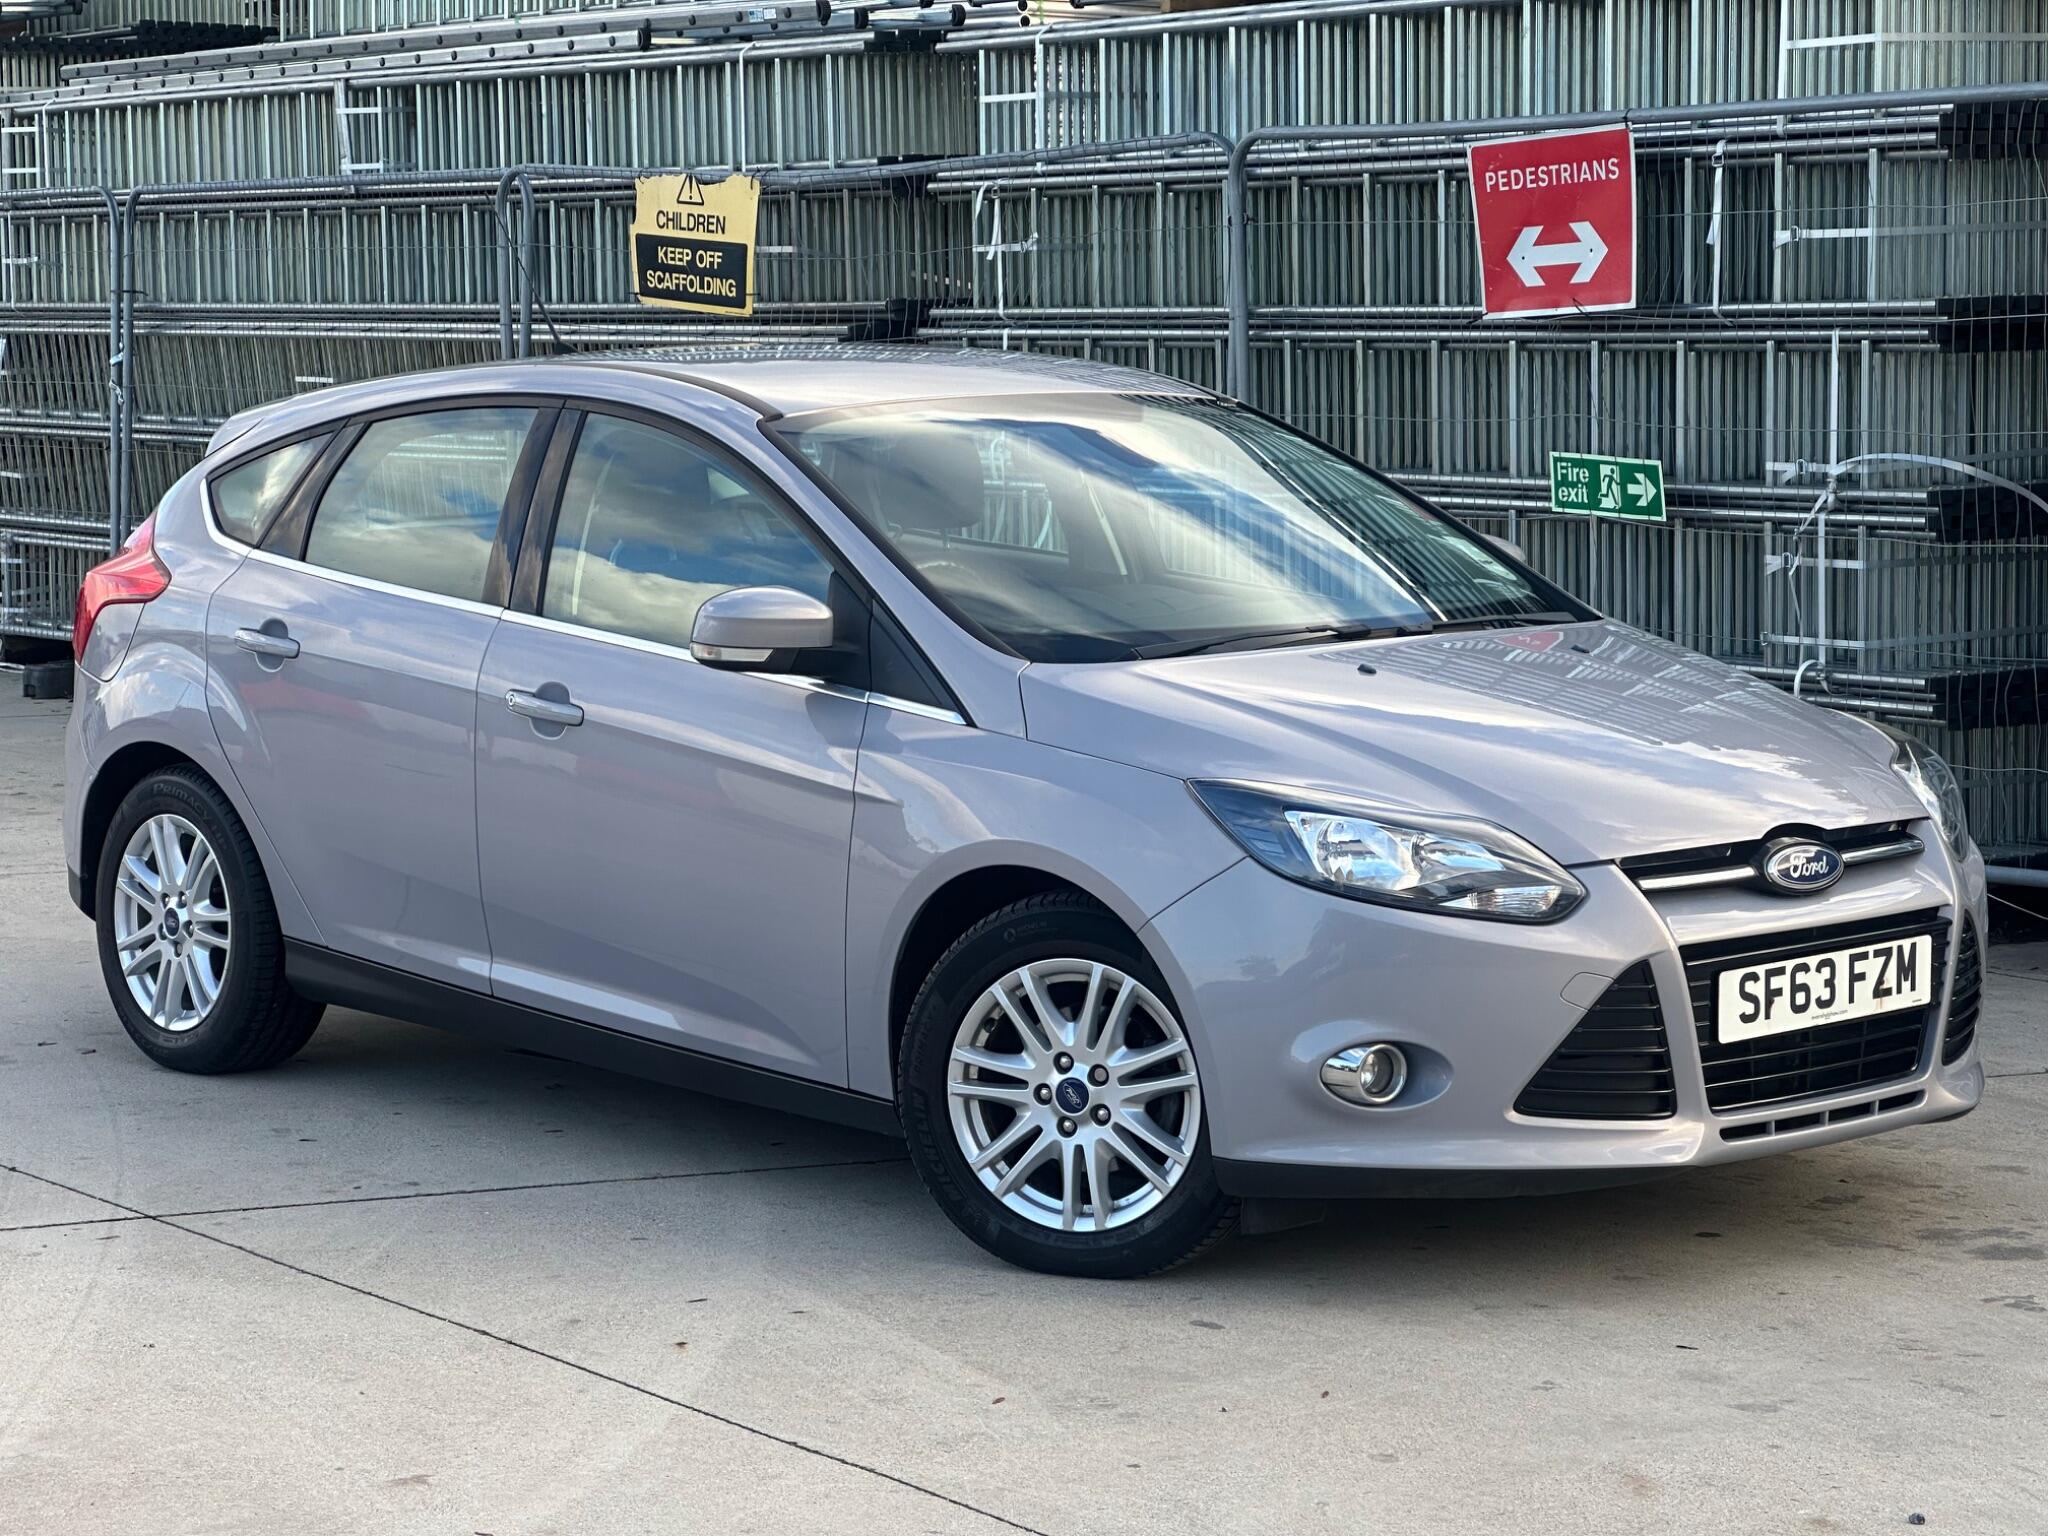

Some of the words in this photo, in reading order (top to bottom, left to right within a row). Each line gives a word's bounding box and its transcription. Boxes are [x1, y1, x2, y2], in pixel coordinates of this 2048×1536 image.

[1485, 157, 1620, 192] PEDESTRIANS
[656, 210, 726, 234] CHILDREN
[657, 246, 692, 266] KEEP
[696, 250, 722, 269] OFF
[646, 270, 736, 297] SCAFFOLDING
[1557, 461, 1589, 482] Fire
[1558, 484, 1588, 503] exit
[1790, 852, 1829, 878] Ford
[1738, 957, 1836, 1024] SF63
[1849, 941, 1917, 1004] FZM
